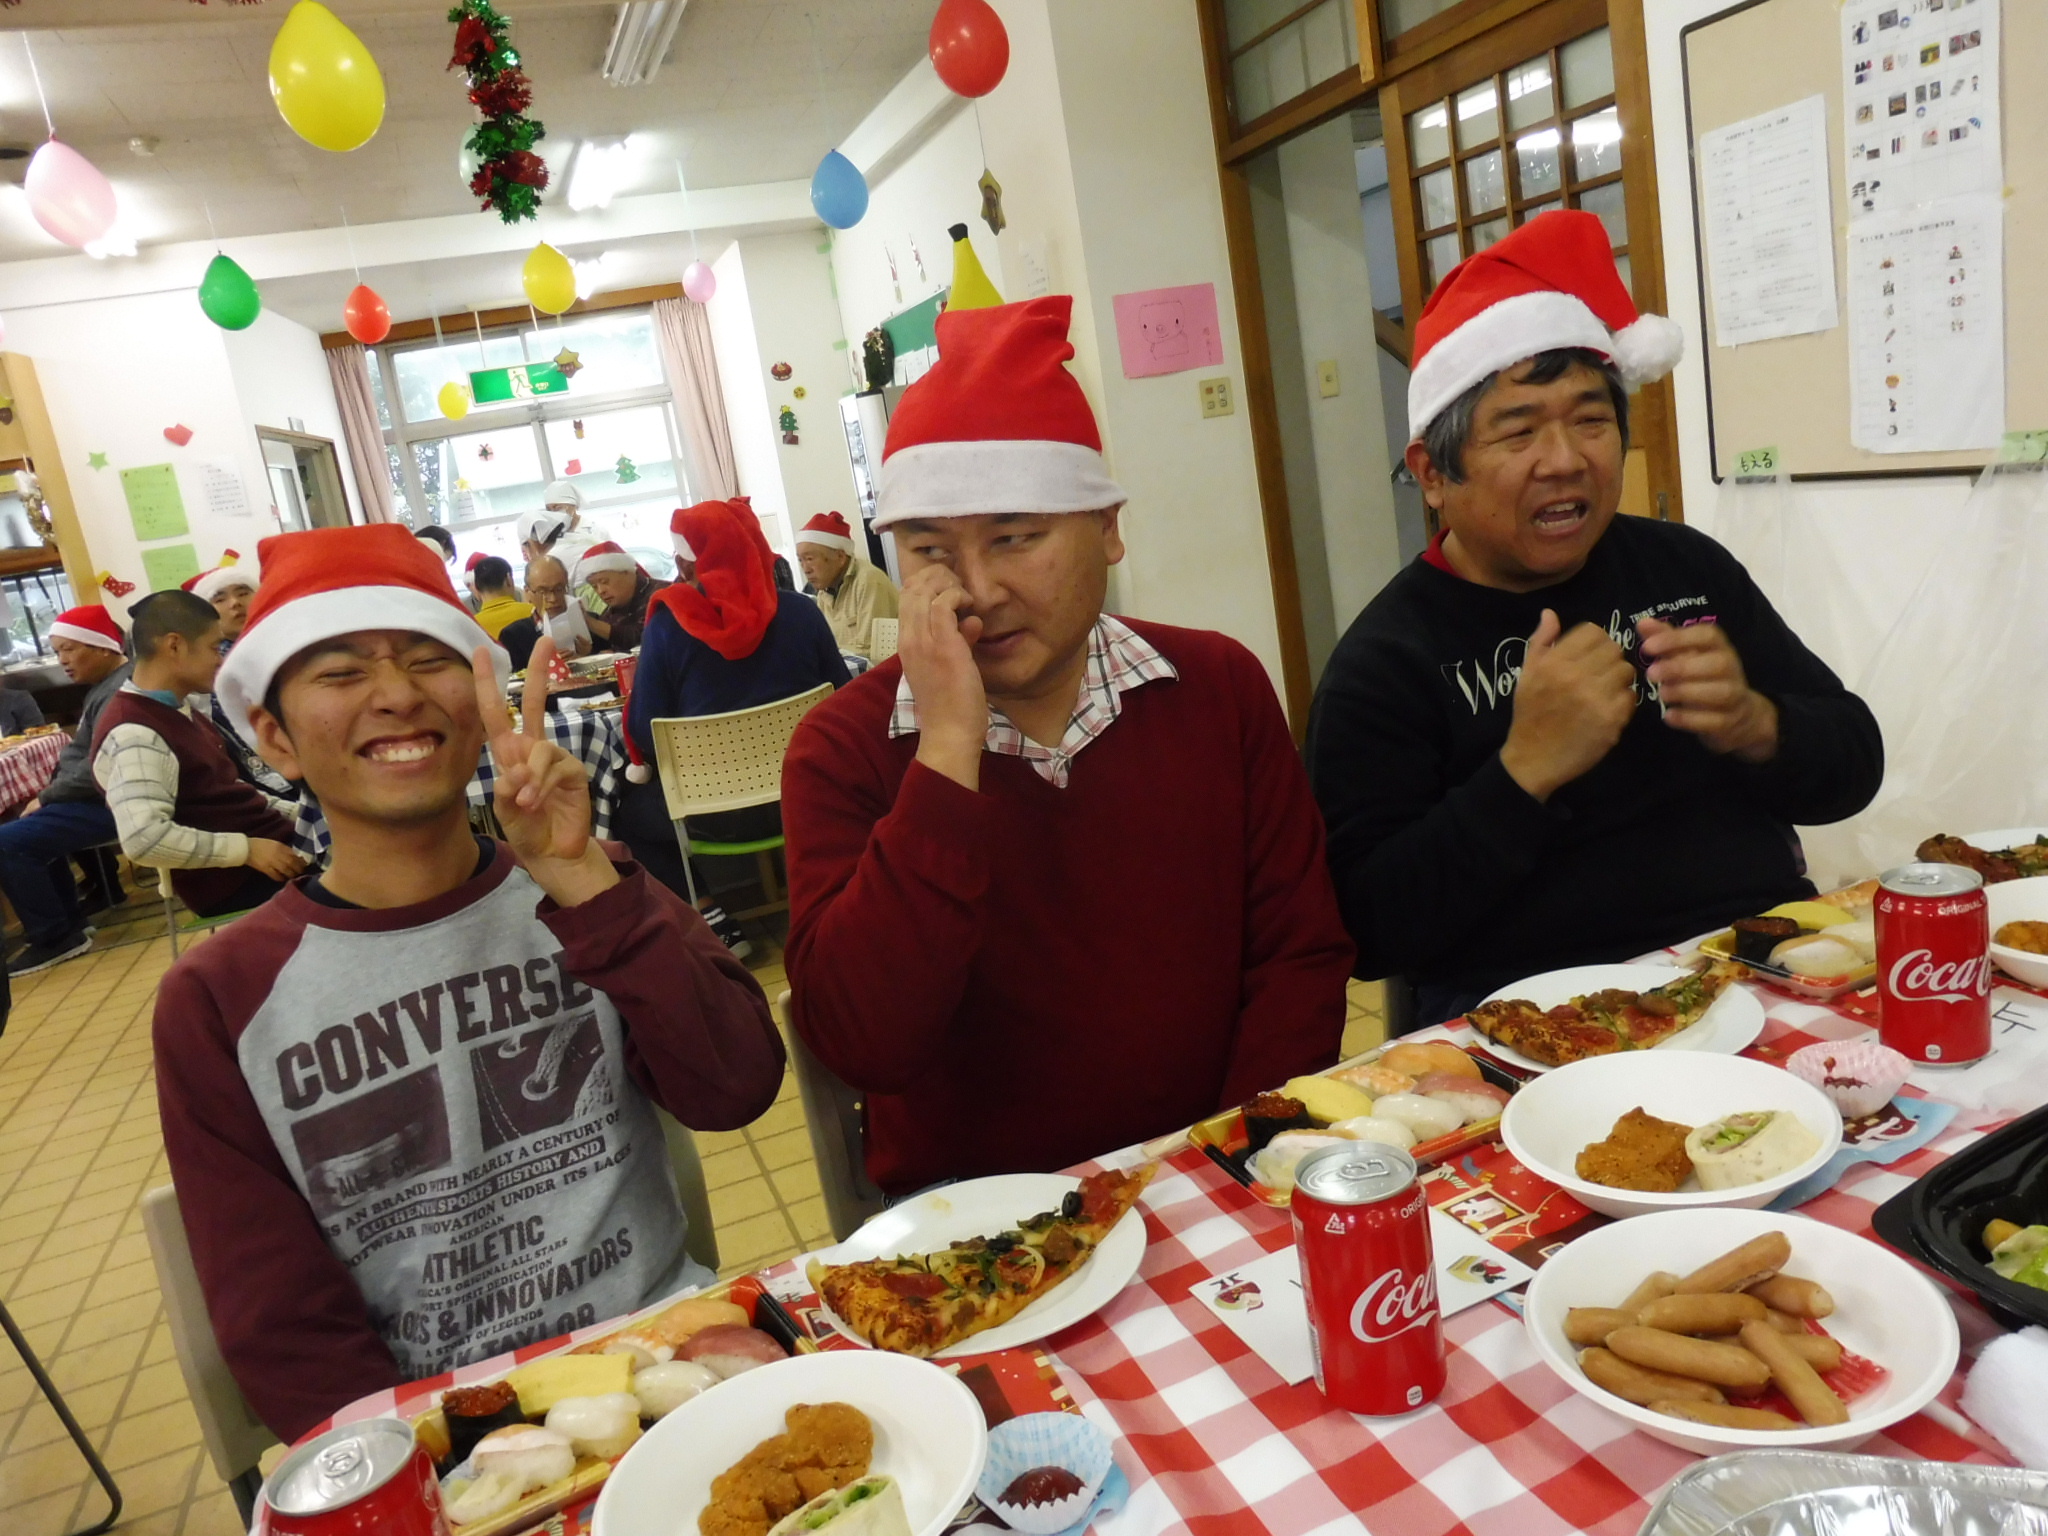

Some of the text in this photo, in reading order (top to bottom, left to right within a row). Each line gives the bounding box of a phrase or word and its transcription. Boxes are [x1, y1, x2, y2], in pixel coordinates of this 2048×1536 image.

[1740, 451, 1773, 473] もえる
[276, 953, 595, 1112] CONVERSE
[346, 1207, 368, 1230] AN
[372, 1182, 428, 1216] BRAND
[462, 1150, 514, 1186] NEARLY
[518, 1146, 529, 1160] A
[532, 1117, 604, 1155] CENTURY
[437, 1182, 493, 1214] SPORTS
[495, 1154, 564, 1190] HISTORY
[566, 1140, 602, 1164] AND
[501, 1178, 556, 1208] UNDER
[563, 1167, 588, 1186] ITS
[423, 1215, 545, 1285] ATHLETIC
[449, 1214, 505, 1246] AMERICAN
[438, 1310, 462, 1342] &
[466, 1227, 633, 1330] INNOVATORS
[447, 1286, 485, 1308] SPIRIT
[487, 1257, 553, 1293] DEDICATION
[455, 1261, 508, 1292] ORIGINAL
[511, 1253, 533, 1269] ALL
[534, 1236, 569, 1257] STARS
[425, 1308, 544, 1358] A STORY OF LEGENDS
